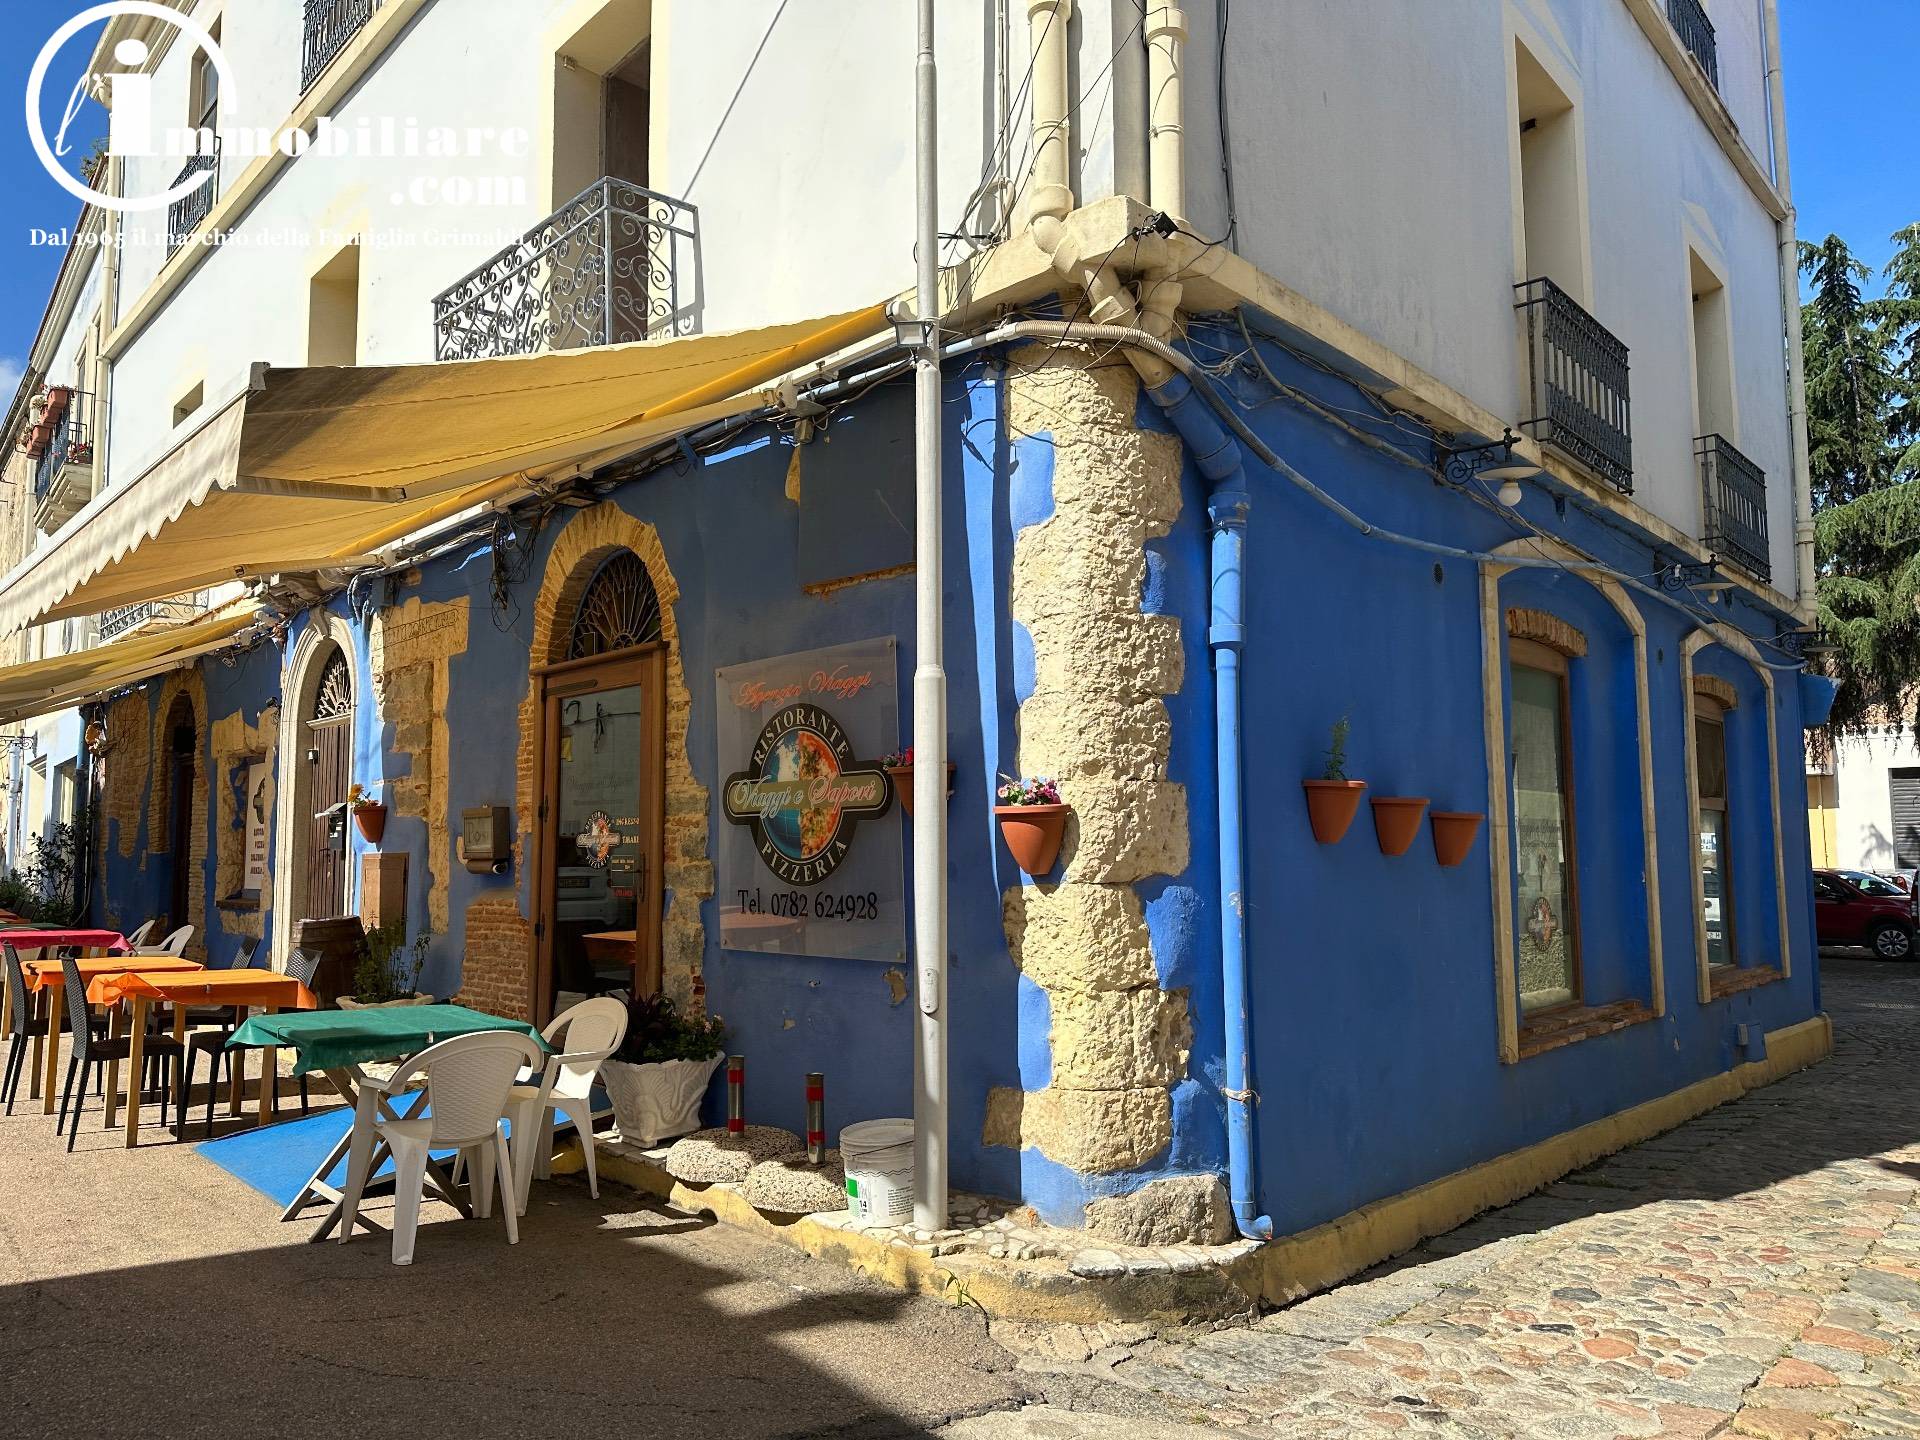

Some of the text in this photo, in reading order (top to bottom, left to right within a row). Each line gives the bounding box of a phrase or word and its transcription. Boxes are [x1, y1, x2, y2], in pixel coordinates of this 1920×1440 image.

[808, 664, 872, 699] Viaggi
[754, 708, 850, 767] RISTORANTE
[733, 774, 877, 819] Viaggi e Sapori
[761, 840, 847, 882] PIZZERIA
[737, 887, 878, 922] Tel. 0782 624928
